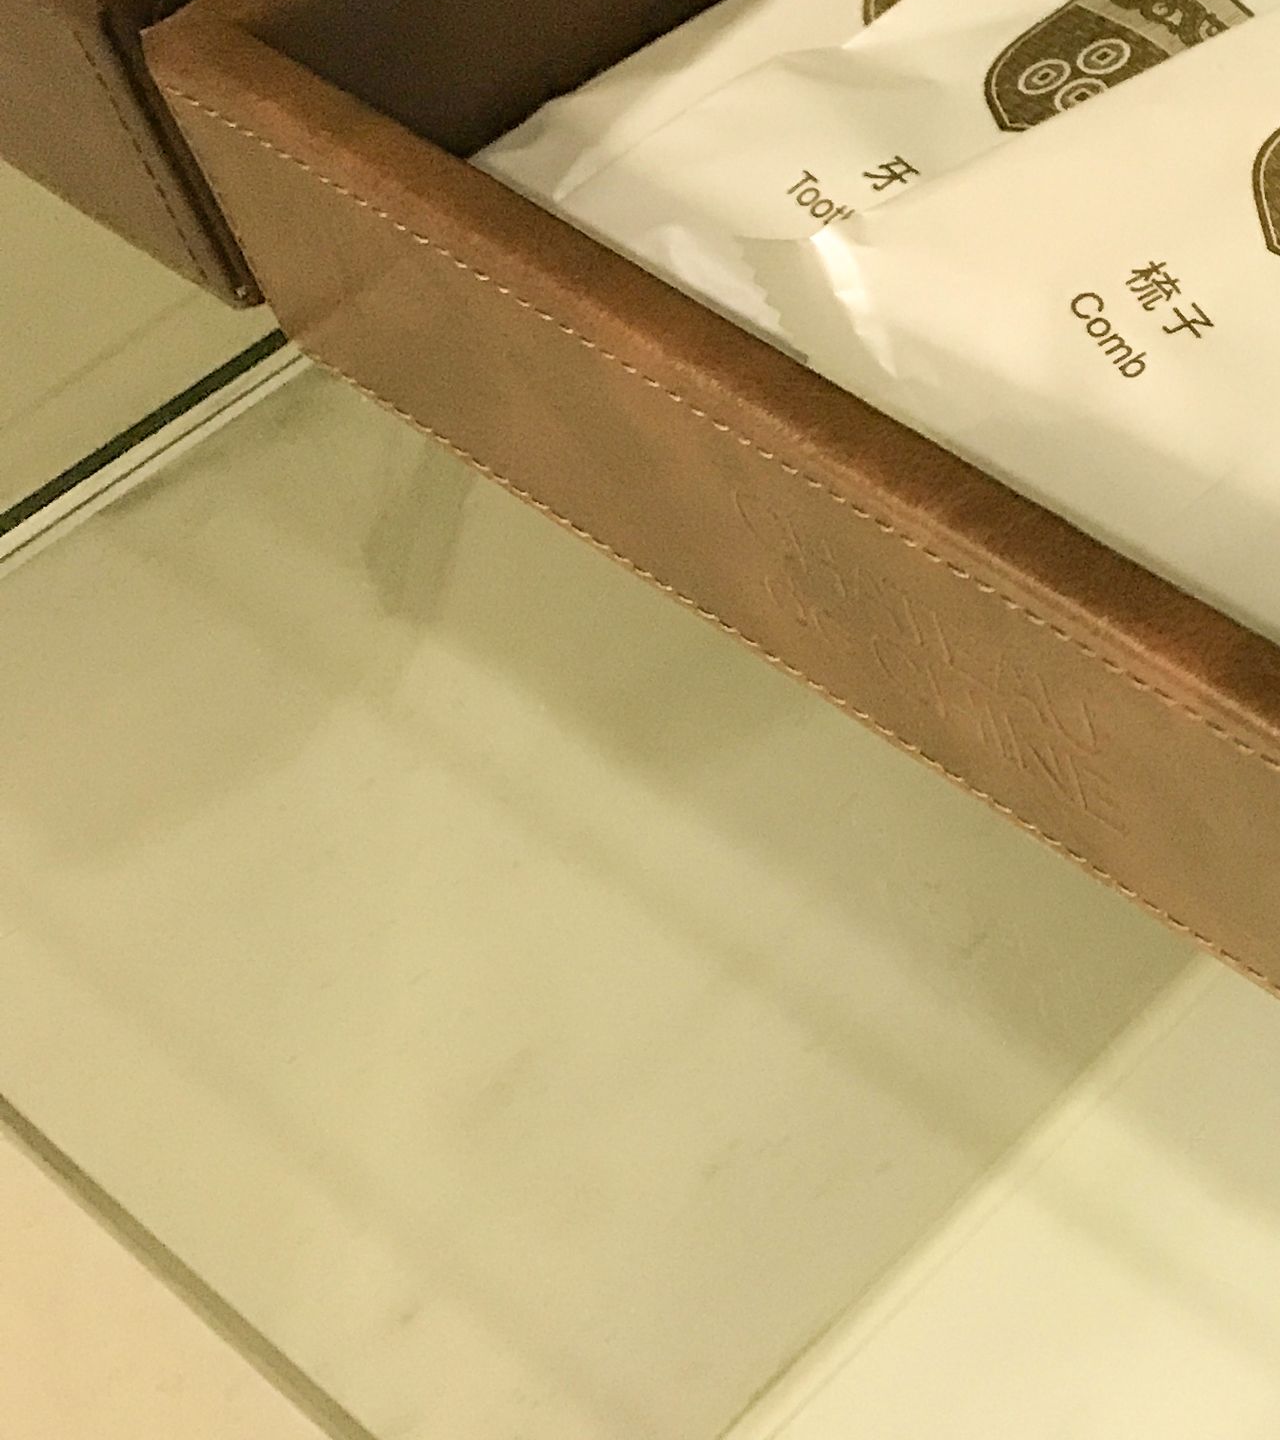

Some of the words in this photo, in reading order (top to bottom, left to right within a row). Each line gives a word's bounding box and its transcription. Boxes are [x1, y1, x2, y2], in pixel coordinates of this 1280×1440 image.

[862, 155, 920, 191] 牙
[1070, 291, 1146, 379] Comb
[1125, 260, 1215, 340] 梳子
